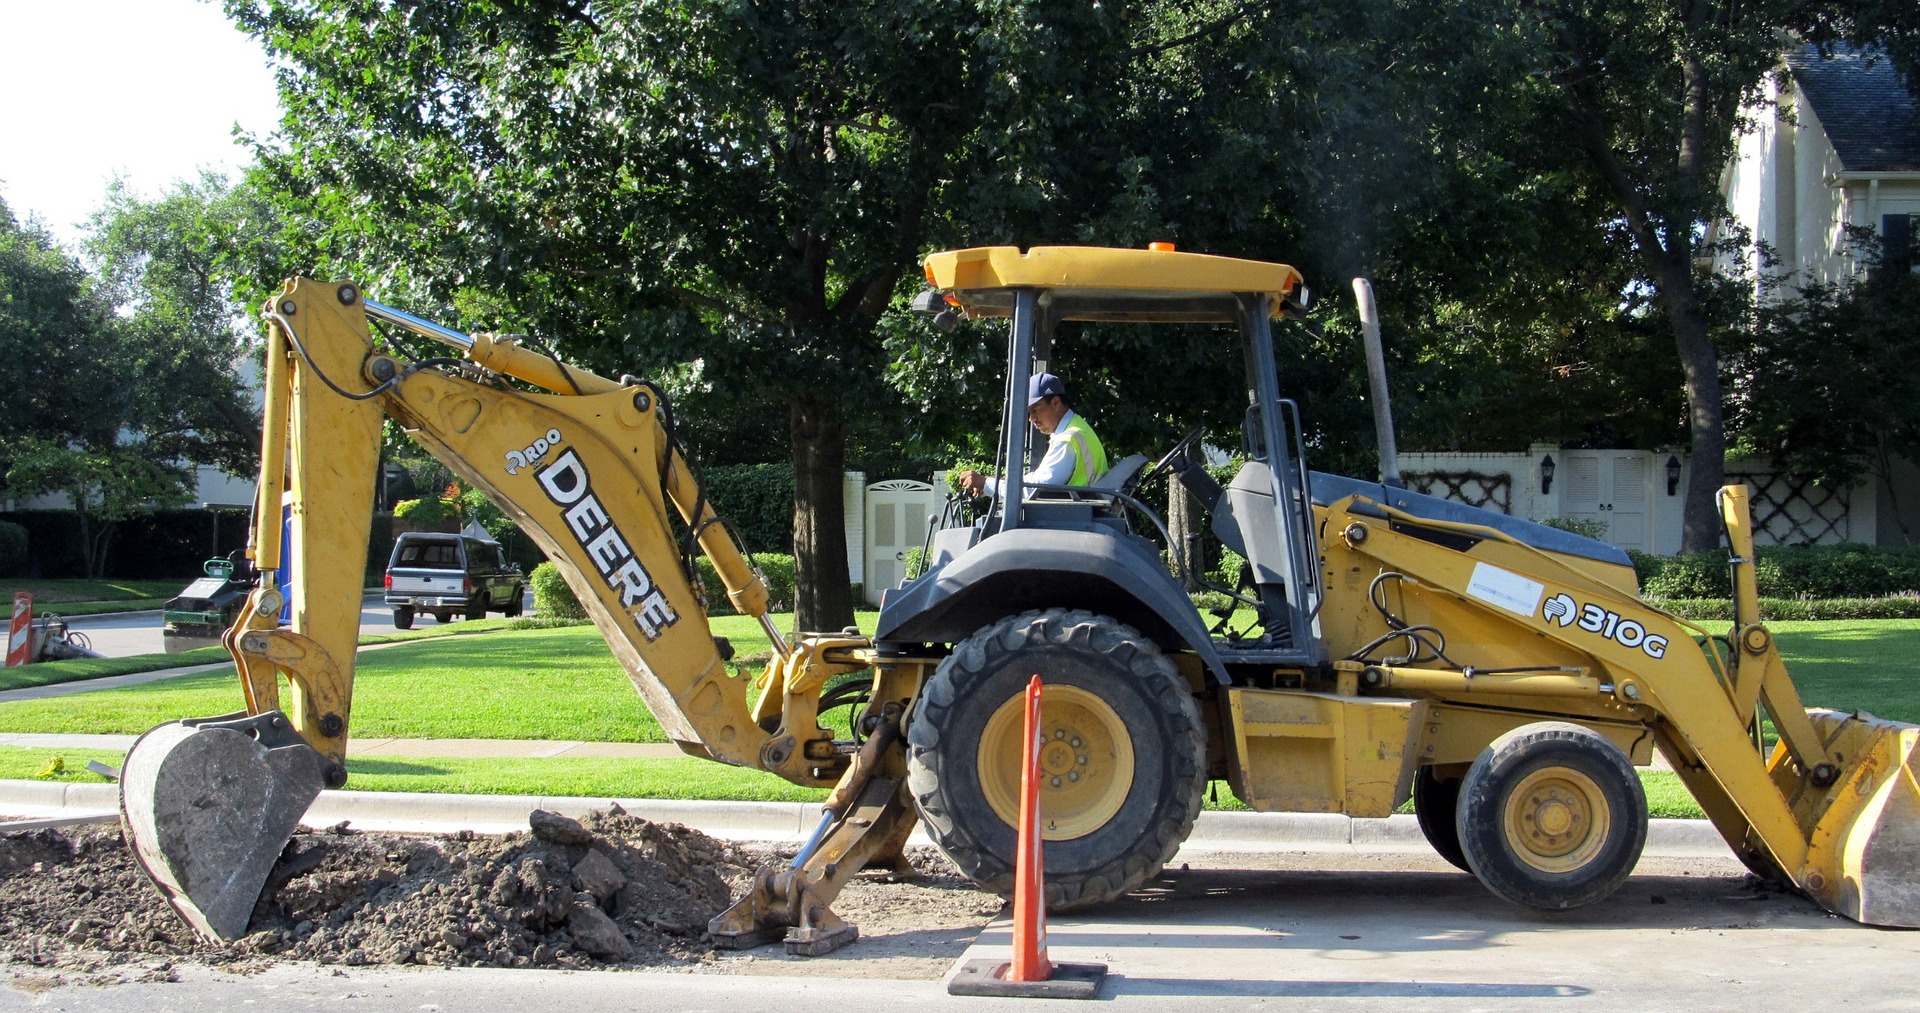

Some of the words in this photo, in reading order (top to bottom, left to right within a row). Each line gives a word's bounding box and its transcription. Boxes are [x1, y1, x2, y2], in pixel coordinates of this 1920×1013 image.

[522, 428, 561, 464] RDO
[537, 448, 678, 640] DEERE
[1577, 603, 1669, 659] 310G
